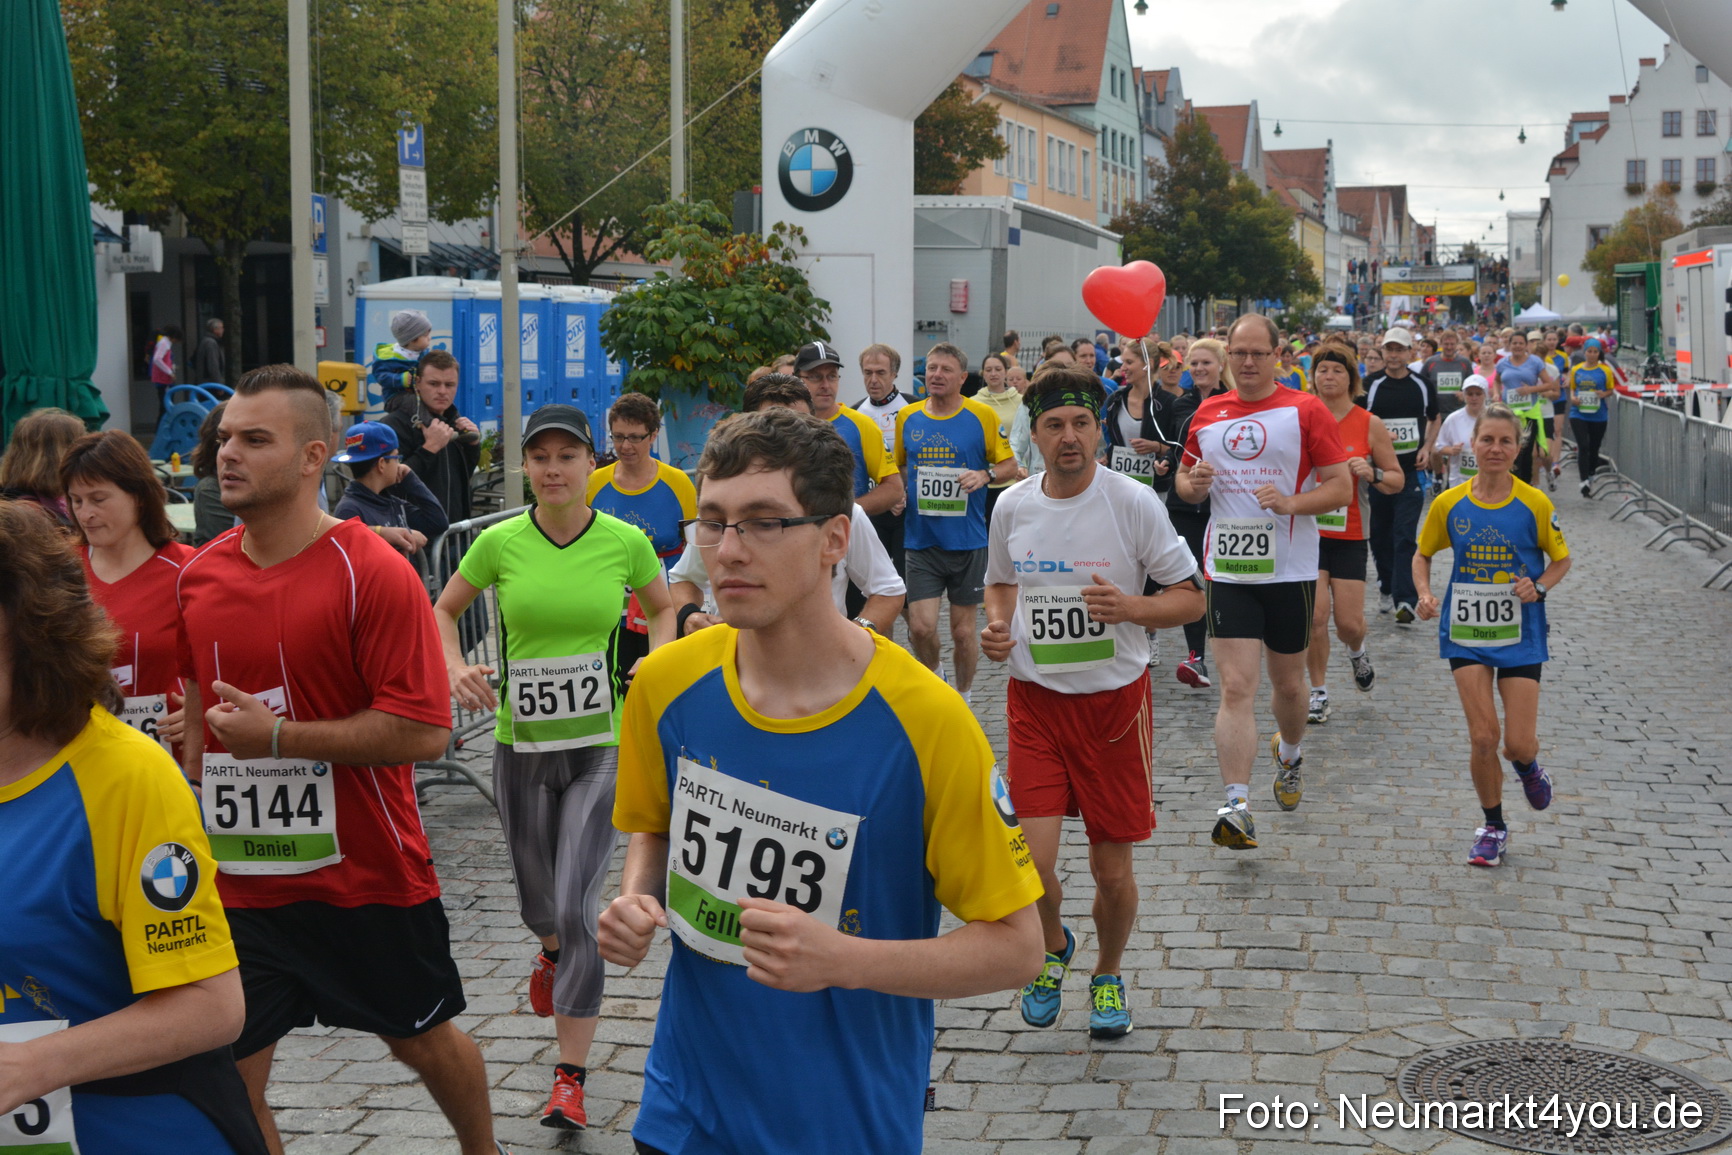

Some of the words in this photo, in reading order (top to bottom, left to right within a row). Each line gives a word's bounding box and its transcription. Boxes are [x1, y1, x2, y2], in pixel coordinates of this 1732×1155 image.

[783, 129, 847, 157] BMW
[348, 278, 355, 296] 3
[1386, 427, 1414, 440] 031
[1116, 457, 1151, 474] 5042
[1461, 456, 1478, 467] 55
[921, 479, 962, 498] 5097
[927, 501, 954, 510] Stephan
[1218, 533, 1269, 556] 5229
[1074, 558, 1111, 567] energie
[1226, 561, 1258, 571] Andreas
[1025, 595, 1050, 603] PARTL
[1453, 589, 1473, 597] PARTL
[1457, 599, 1514, 622] 5103
[1032, 607, 1106, 640] 5505
[1473, 629, 1497, 638] Doris
[510, 667, 540, 677] PARTL
[541, 664, 589, 676] Neumarkt
[519, 676, 601, 716] 5512
[121, 706, 149, 715] markt
[205, 766, 243, 777] PARTL
[246, 765, 307, 777] Neumarkt
[215, 783, 323, 829] 5144
[678, 776, 727, 810] PARTL
[732, 798, 818, 841] Neumarkt
[244, 840, 297, 857] Daniel
[682, 809, 826, 914] 5193
[145, 915, 206, 941] PARTL
[147, 932, 207, 954] Neumarkt
